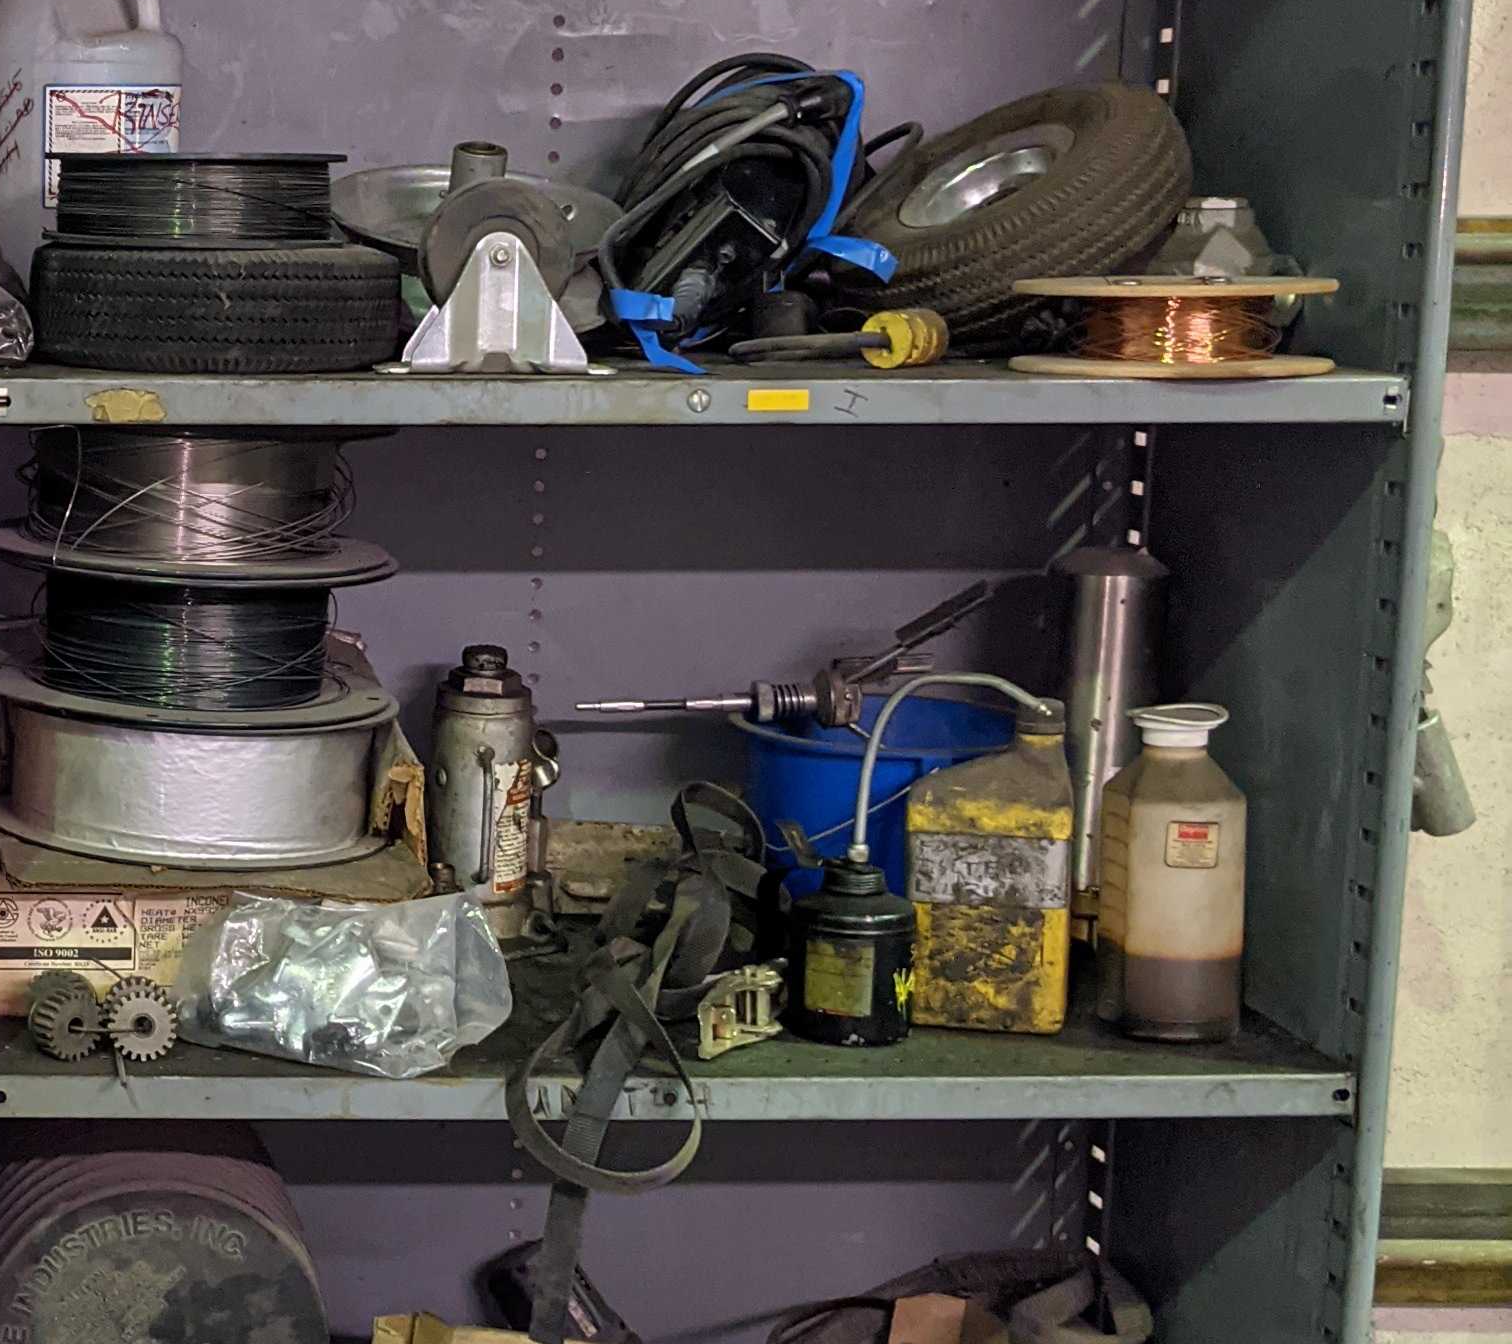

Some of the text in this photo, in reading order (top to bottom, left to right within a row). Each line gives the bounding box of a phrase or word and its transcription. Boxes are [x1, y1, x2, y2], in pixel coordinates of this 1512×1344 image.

[140, 915, 197, 925] DIAMETER
[140, 932, 168, 941] TARE
[139, 940, 160, 949] NET
[33, 947, 80, 958] ISO 9002
